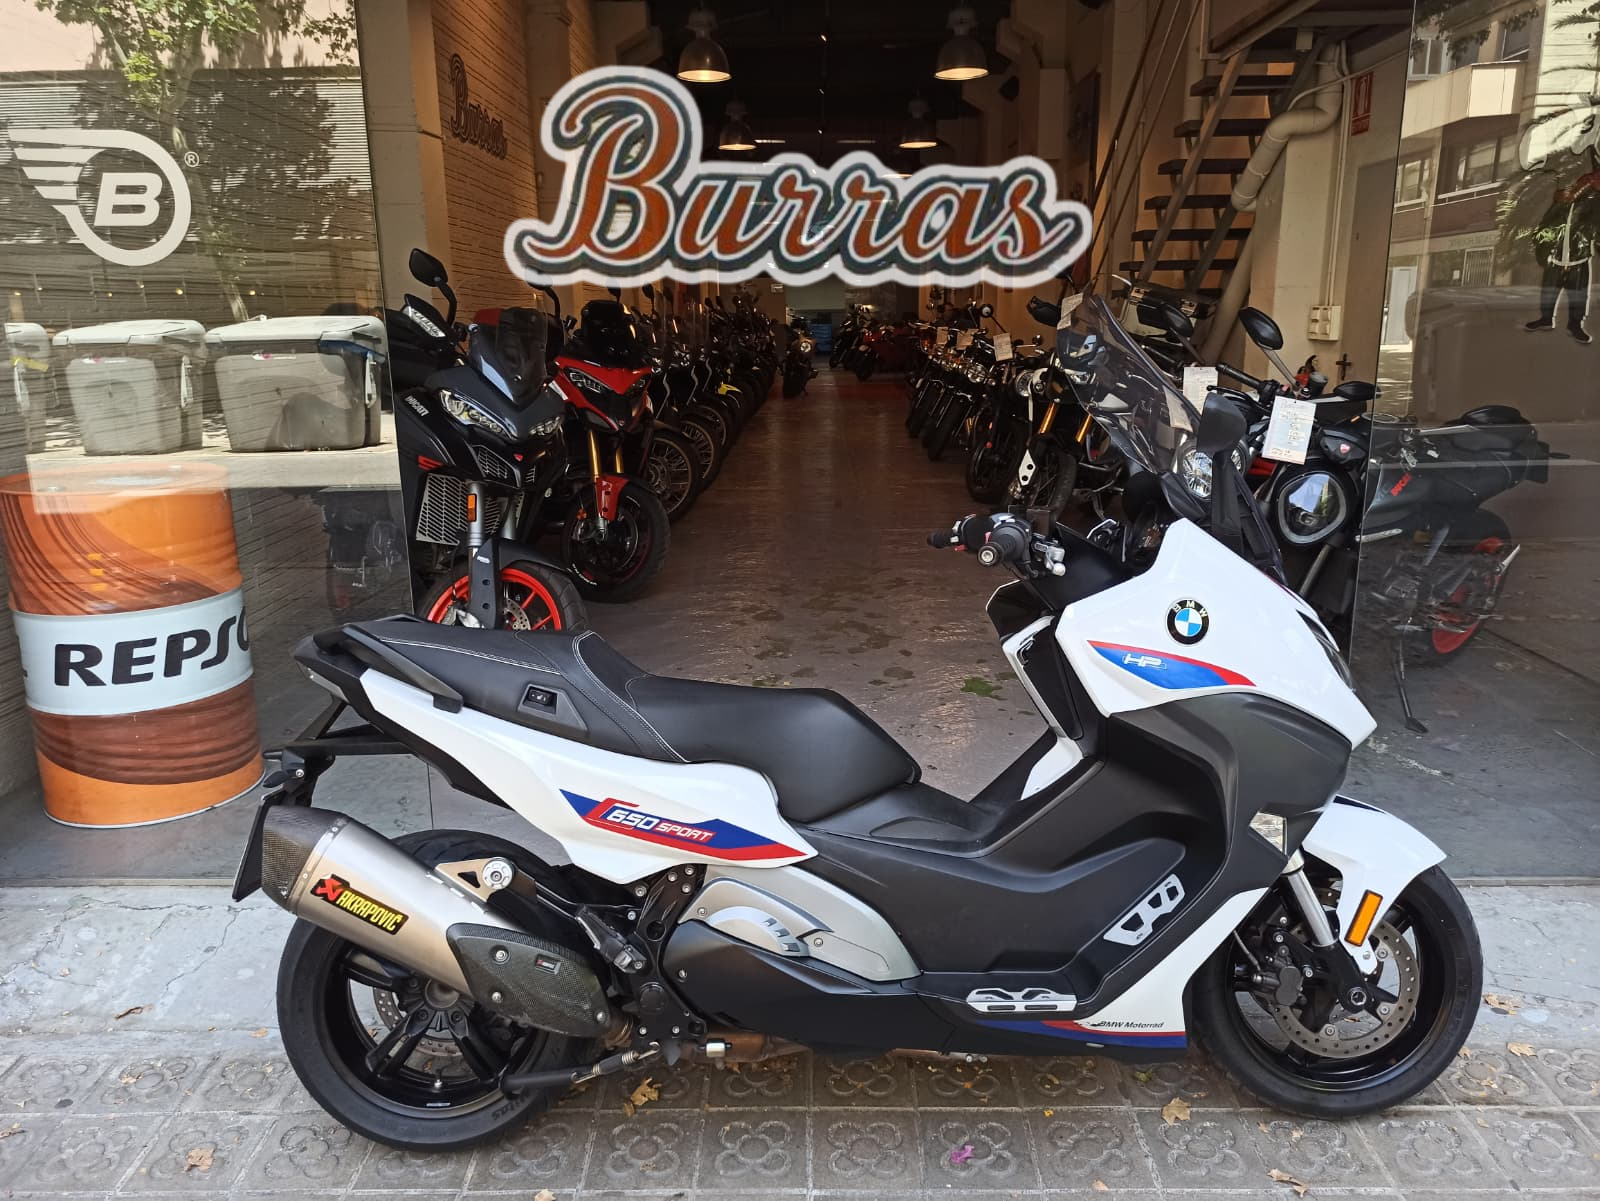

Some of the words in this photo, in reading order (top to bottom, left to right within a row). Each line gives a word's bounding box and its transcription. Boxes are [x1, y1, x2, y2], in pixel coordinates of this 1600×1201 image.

[94, 172, 163, 226] B
[404, 395, 430, 417] DUCATI
[1123, 653, 1163, 668] HP
[606, 809, 660, 831] 650
[656, 822, 713, 841] SPORT
[1099, 1020, 1124, 1028] BMW
